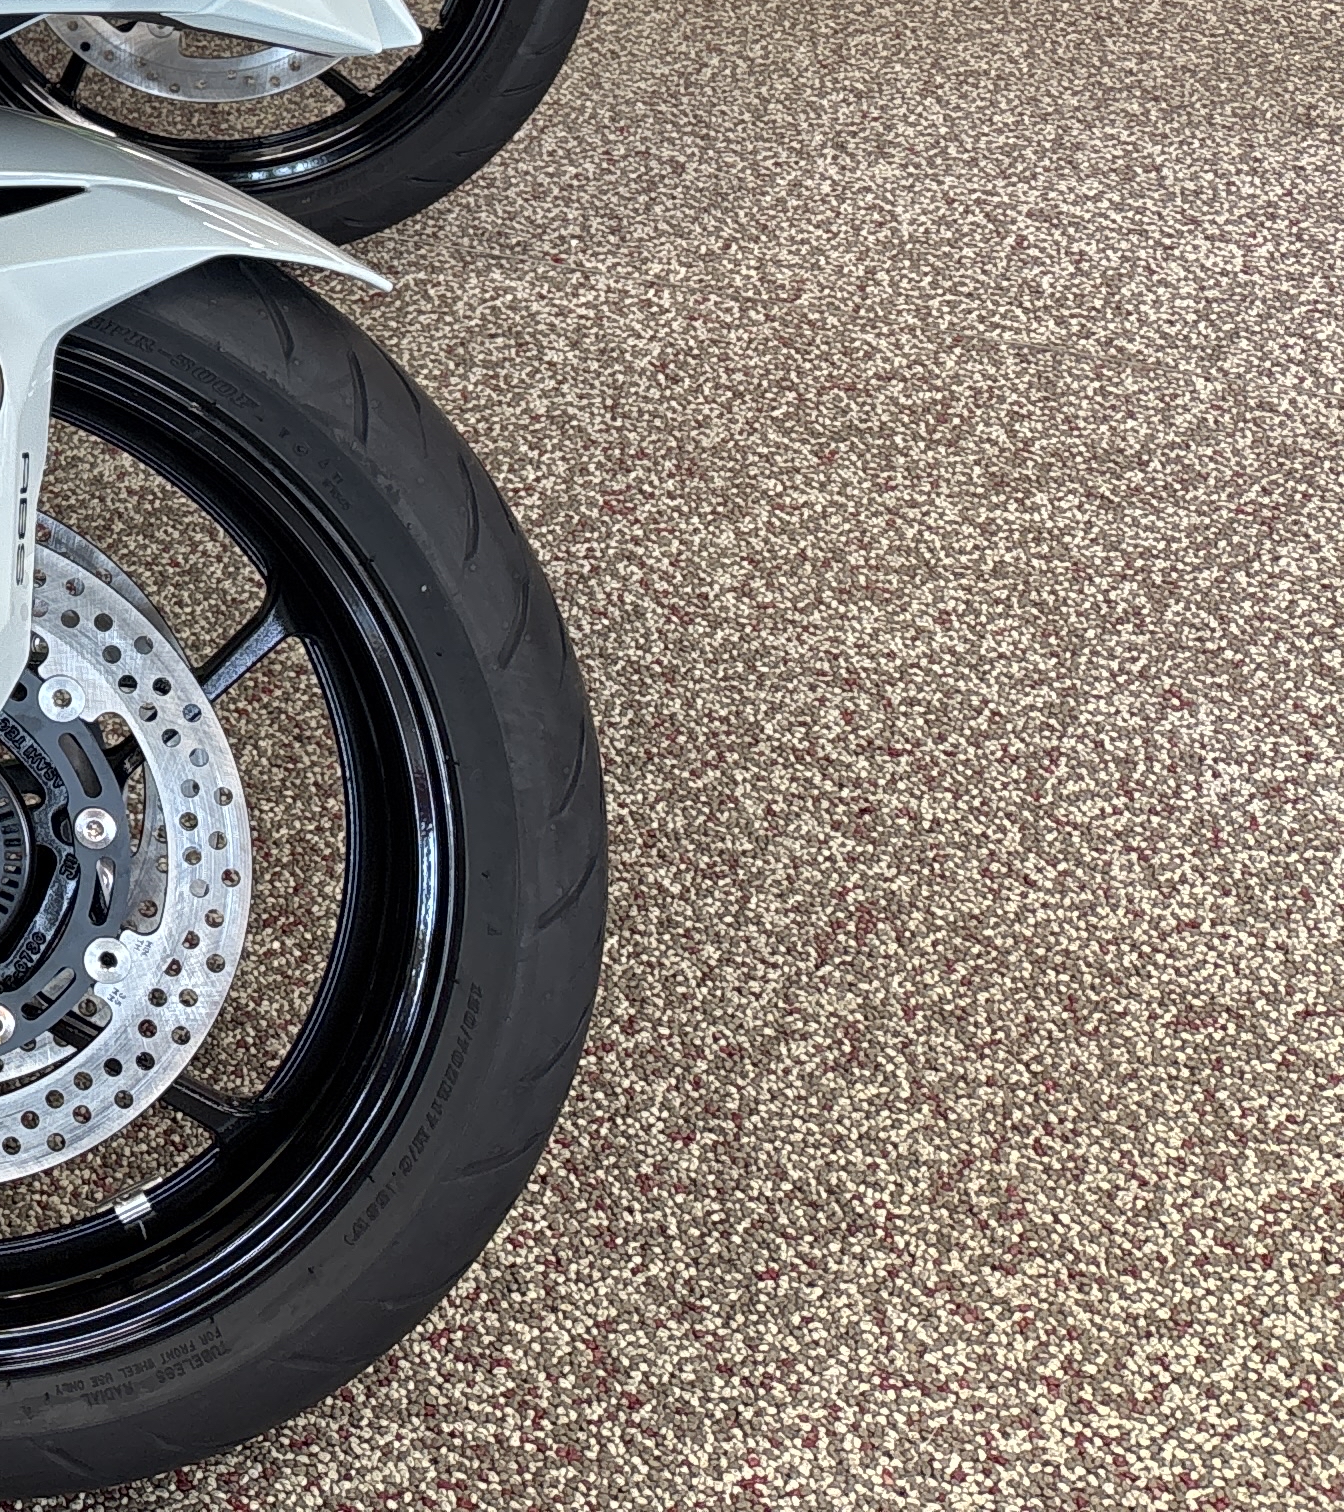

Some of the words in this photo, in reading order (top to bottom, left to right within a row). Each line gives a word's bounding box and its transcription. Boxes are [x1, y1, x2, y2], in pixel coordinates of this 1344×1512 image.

[197, 1326, 223, 1345] FOR
[155, 1340, 232, 1384] TUBELESS
[159, 1339, 195, 1365] FRONT
[117, 1357, 156, 1379] WHEEL
[54, 1379, 85, 1396] ONLY
[89, 1371, 114, 1388] USE
[79, 1380, 134, 1408] RADIAL
